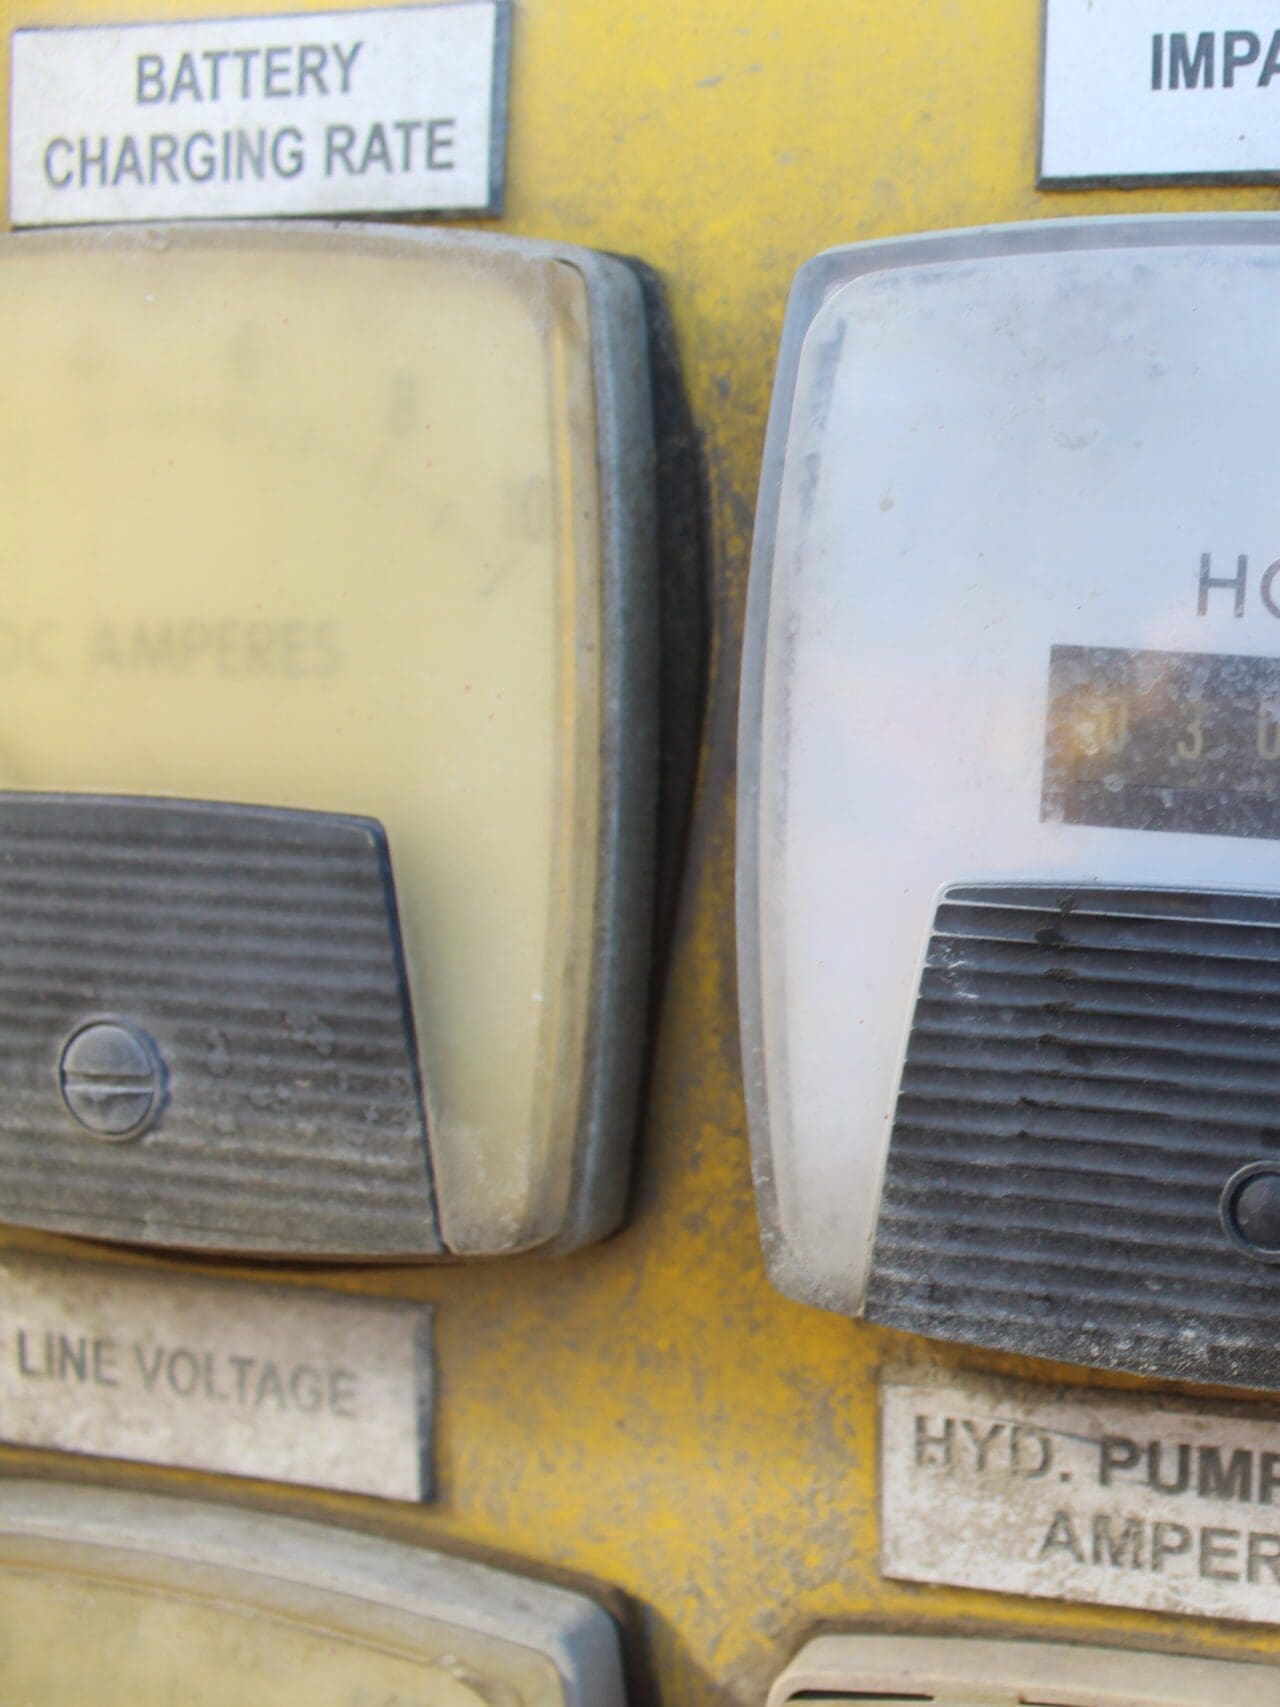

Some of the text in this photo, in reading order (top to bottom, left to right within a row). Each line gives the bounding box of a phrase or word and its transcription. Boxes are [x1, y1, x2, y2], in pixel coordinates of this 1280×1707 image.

[134, 41, 365, 105] BATTERY
[43, 117, 457, 190] CHARGING RATE
[88, 617, 346, 682] AMPERES
[16, 1328, 360, 1418] LINE VOLTAGE
[913, 1413, 1072, 1487] HYD.
